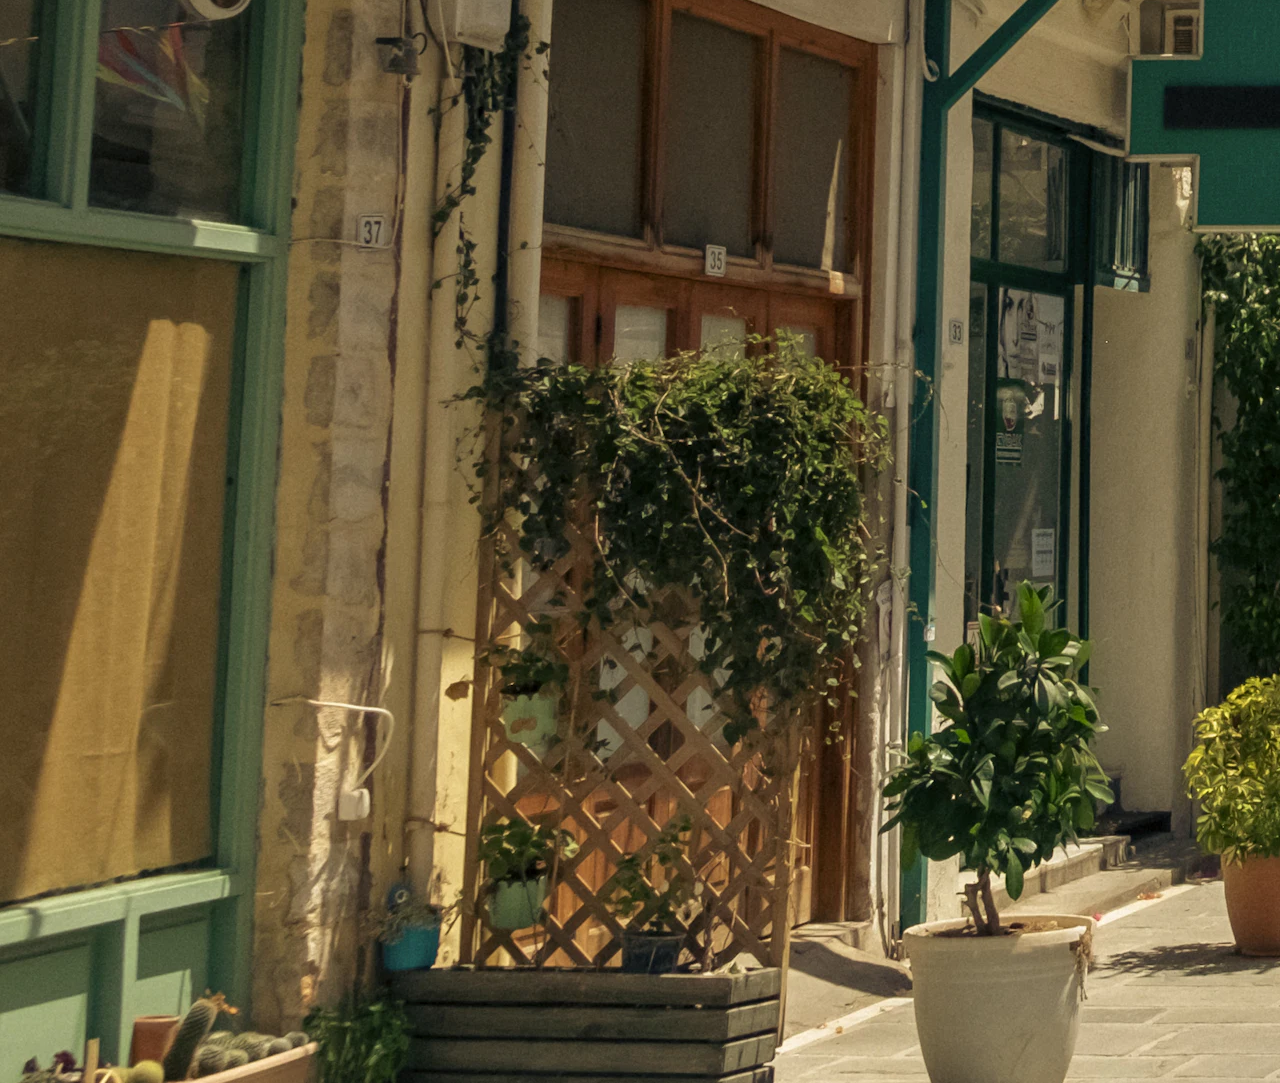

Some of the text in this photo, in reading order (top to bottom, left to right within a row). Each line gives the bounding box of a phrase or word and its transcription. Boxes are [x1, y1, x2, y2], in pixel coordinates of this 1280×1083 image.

[364, 220, 382, 245] 37
[710, 250, 723, 270] 35
[952, 323, 962, 341] 33
